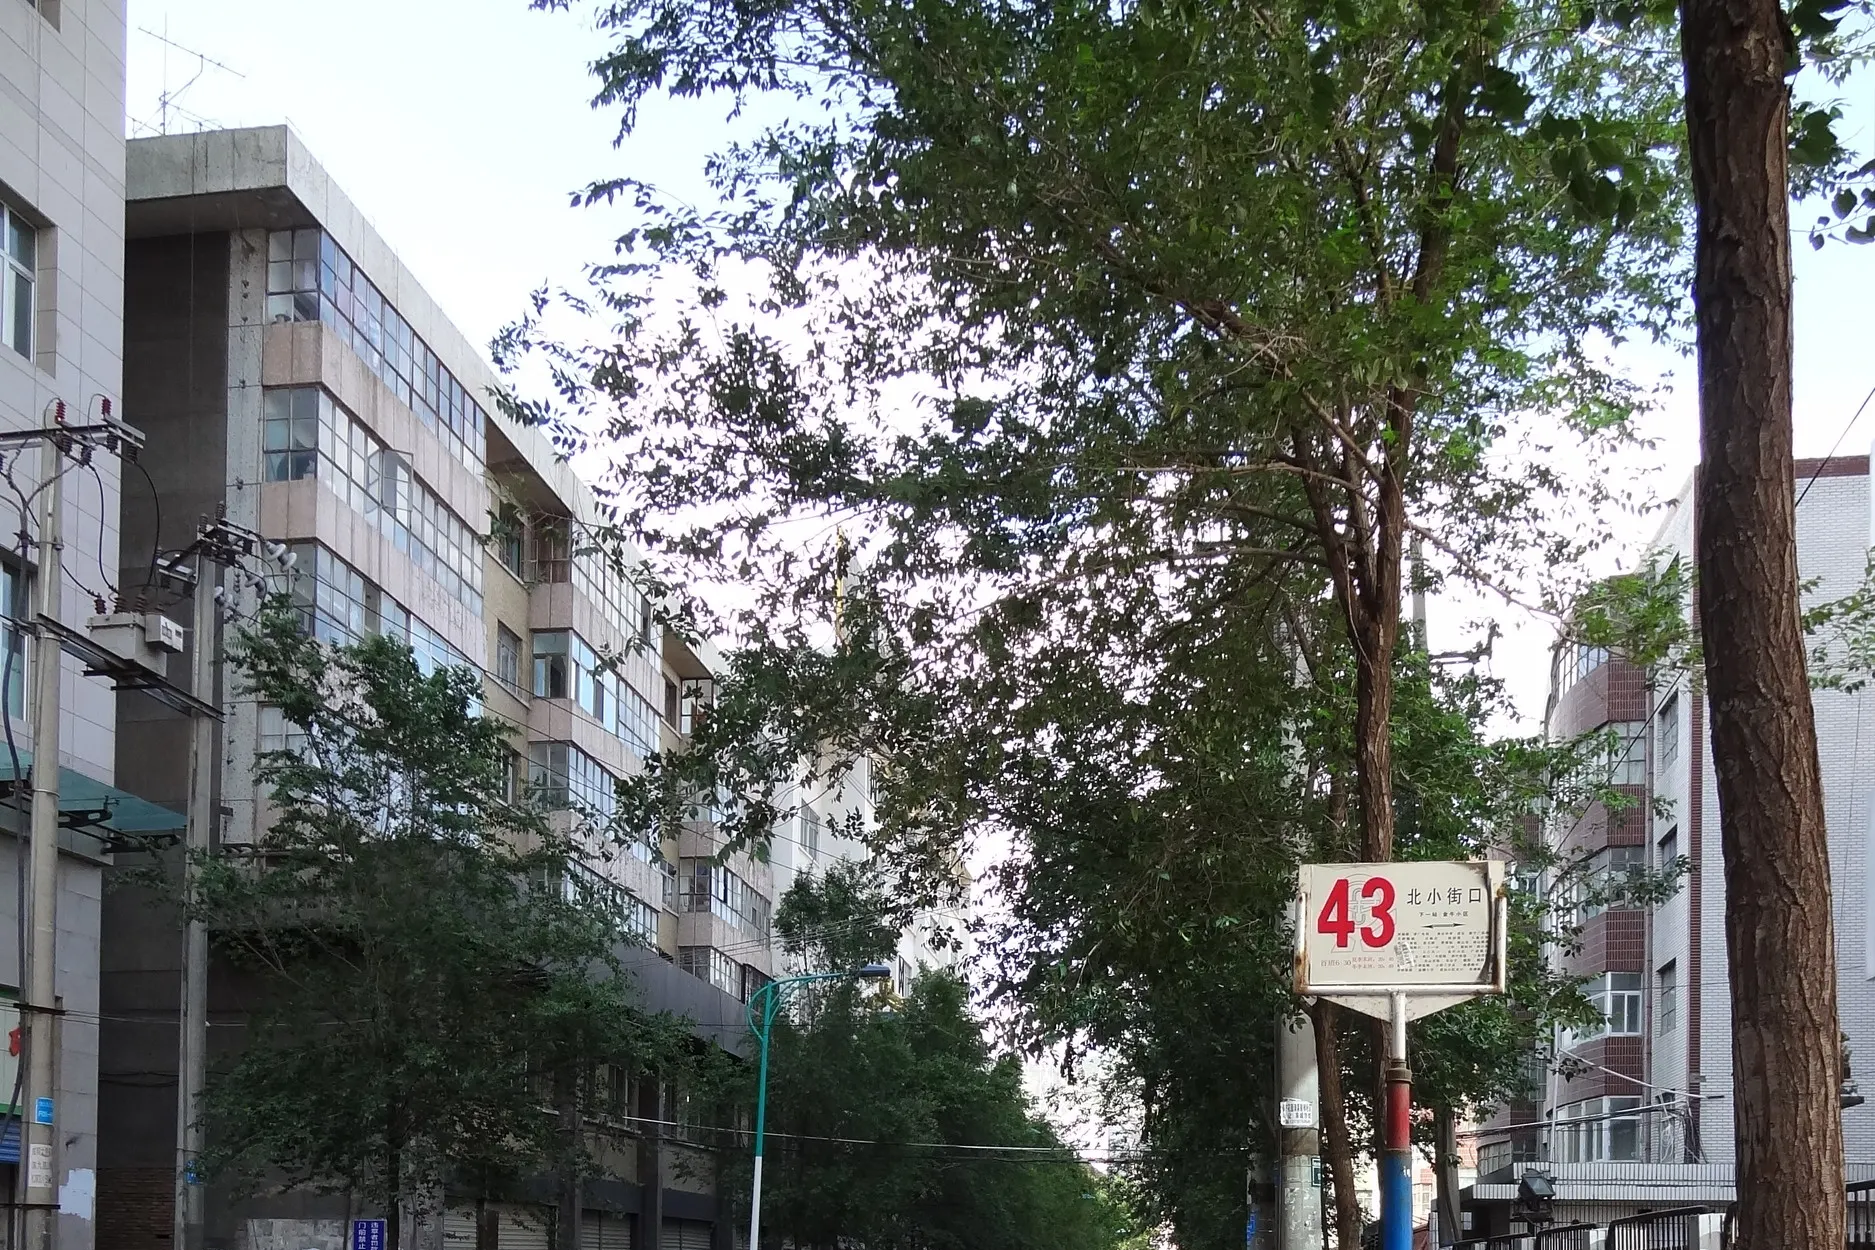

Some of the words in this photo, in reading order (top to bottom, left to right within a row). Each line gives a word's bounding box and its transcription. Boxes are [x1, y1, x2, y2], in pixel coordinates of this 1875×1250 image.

[1317, 877, 1395, 948] 43
[1407, 887, 1481, 905] 北小街口
